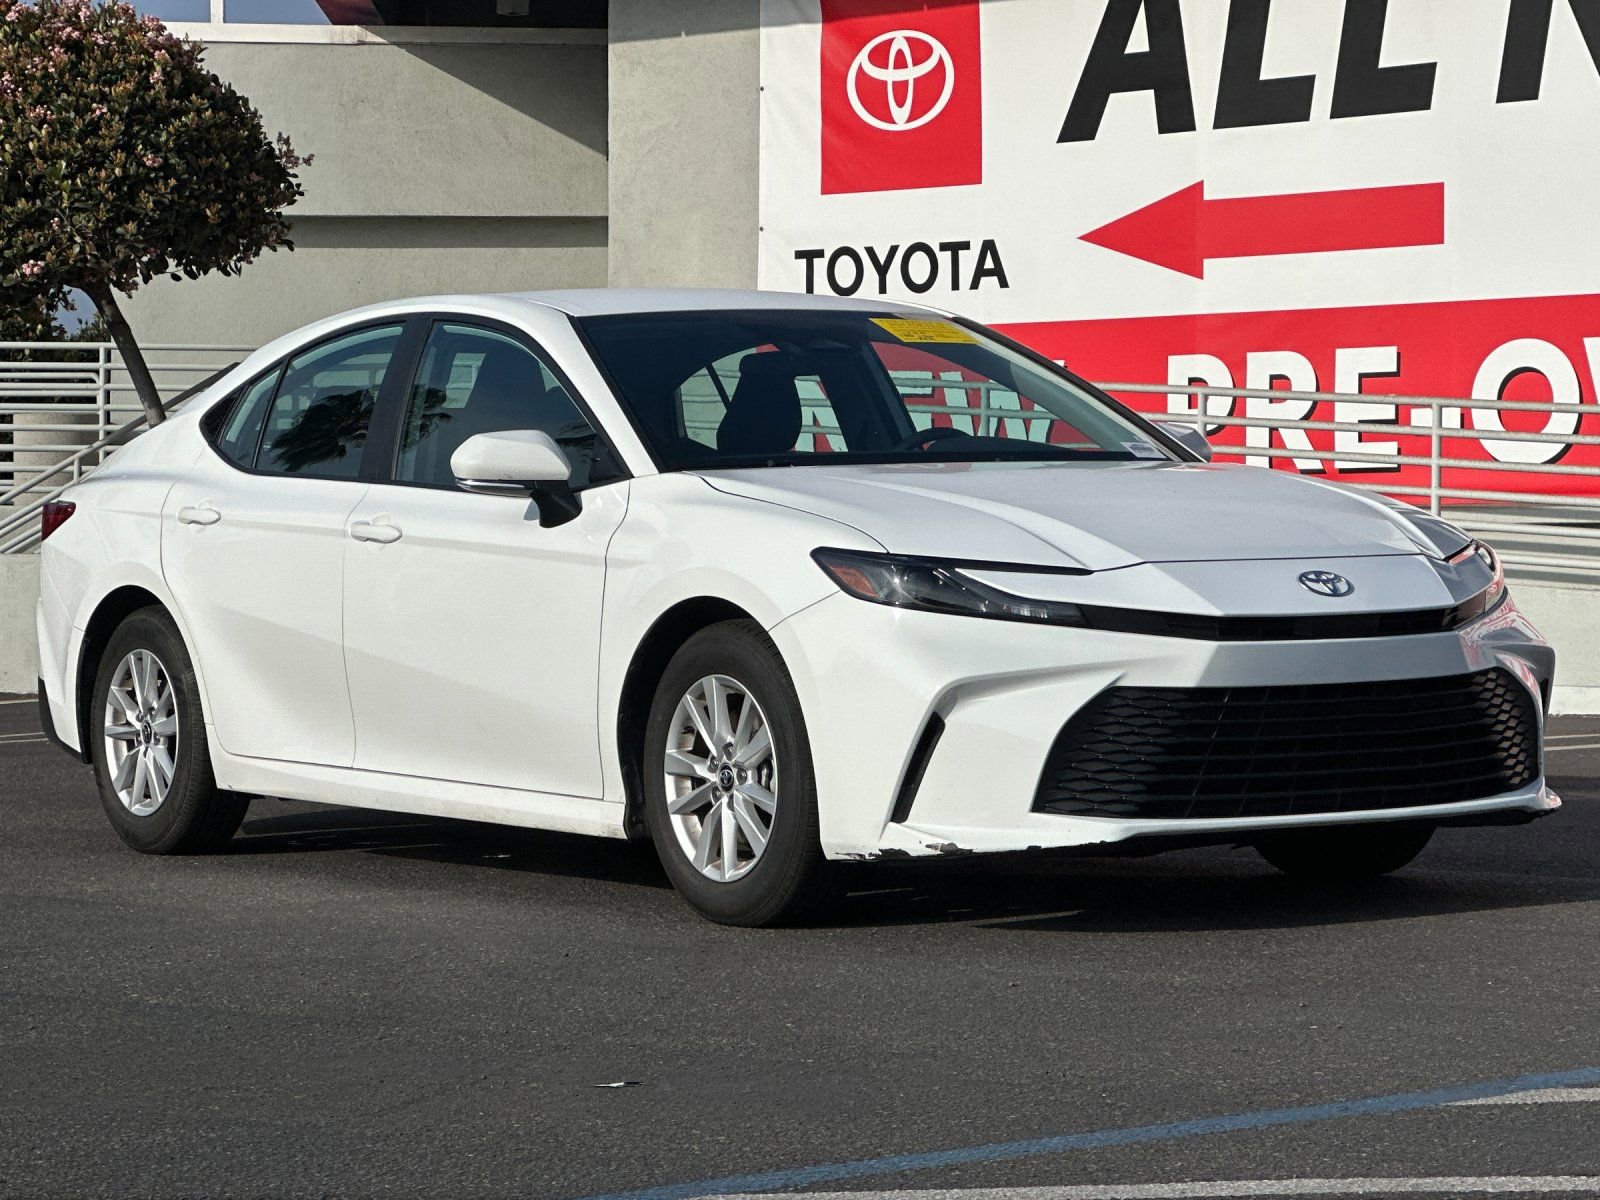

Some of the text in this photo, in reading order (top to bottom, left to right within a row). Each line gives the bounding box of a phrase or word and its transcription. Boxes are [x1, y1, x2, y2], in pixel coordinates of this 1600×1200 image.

[1056, 0, 1438, 144] ALL
[794, 238, 1010, 296] TOYOTA
[1166, 336, 1600, 474] PRE-O
